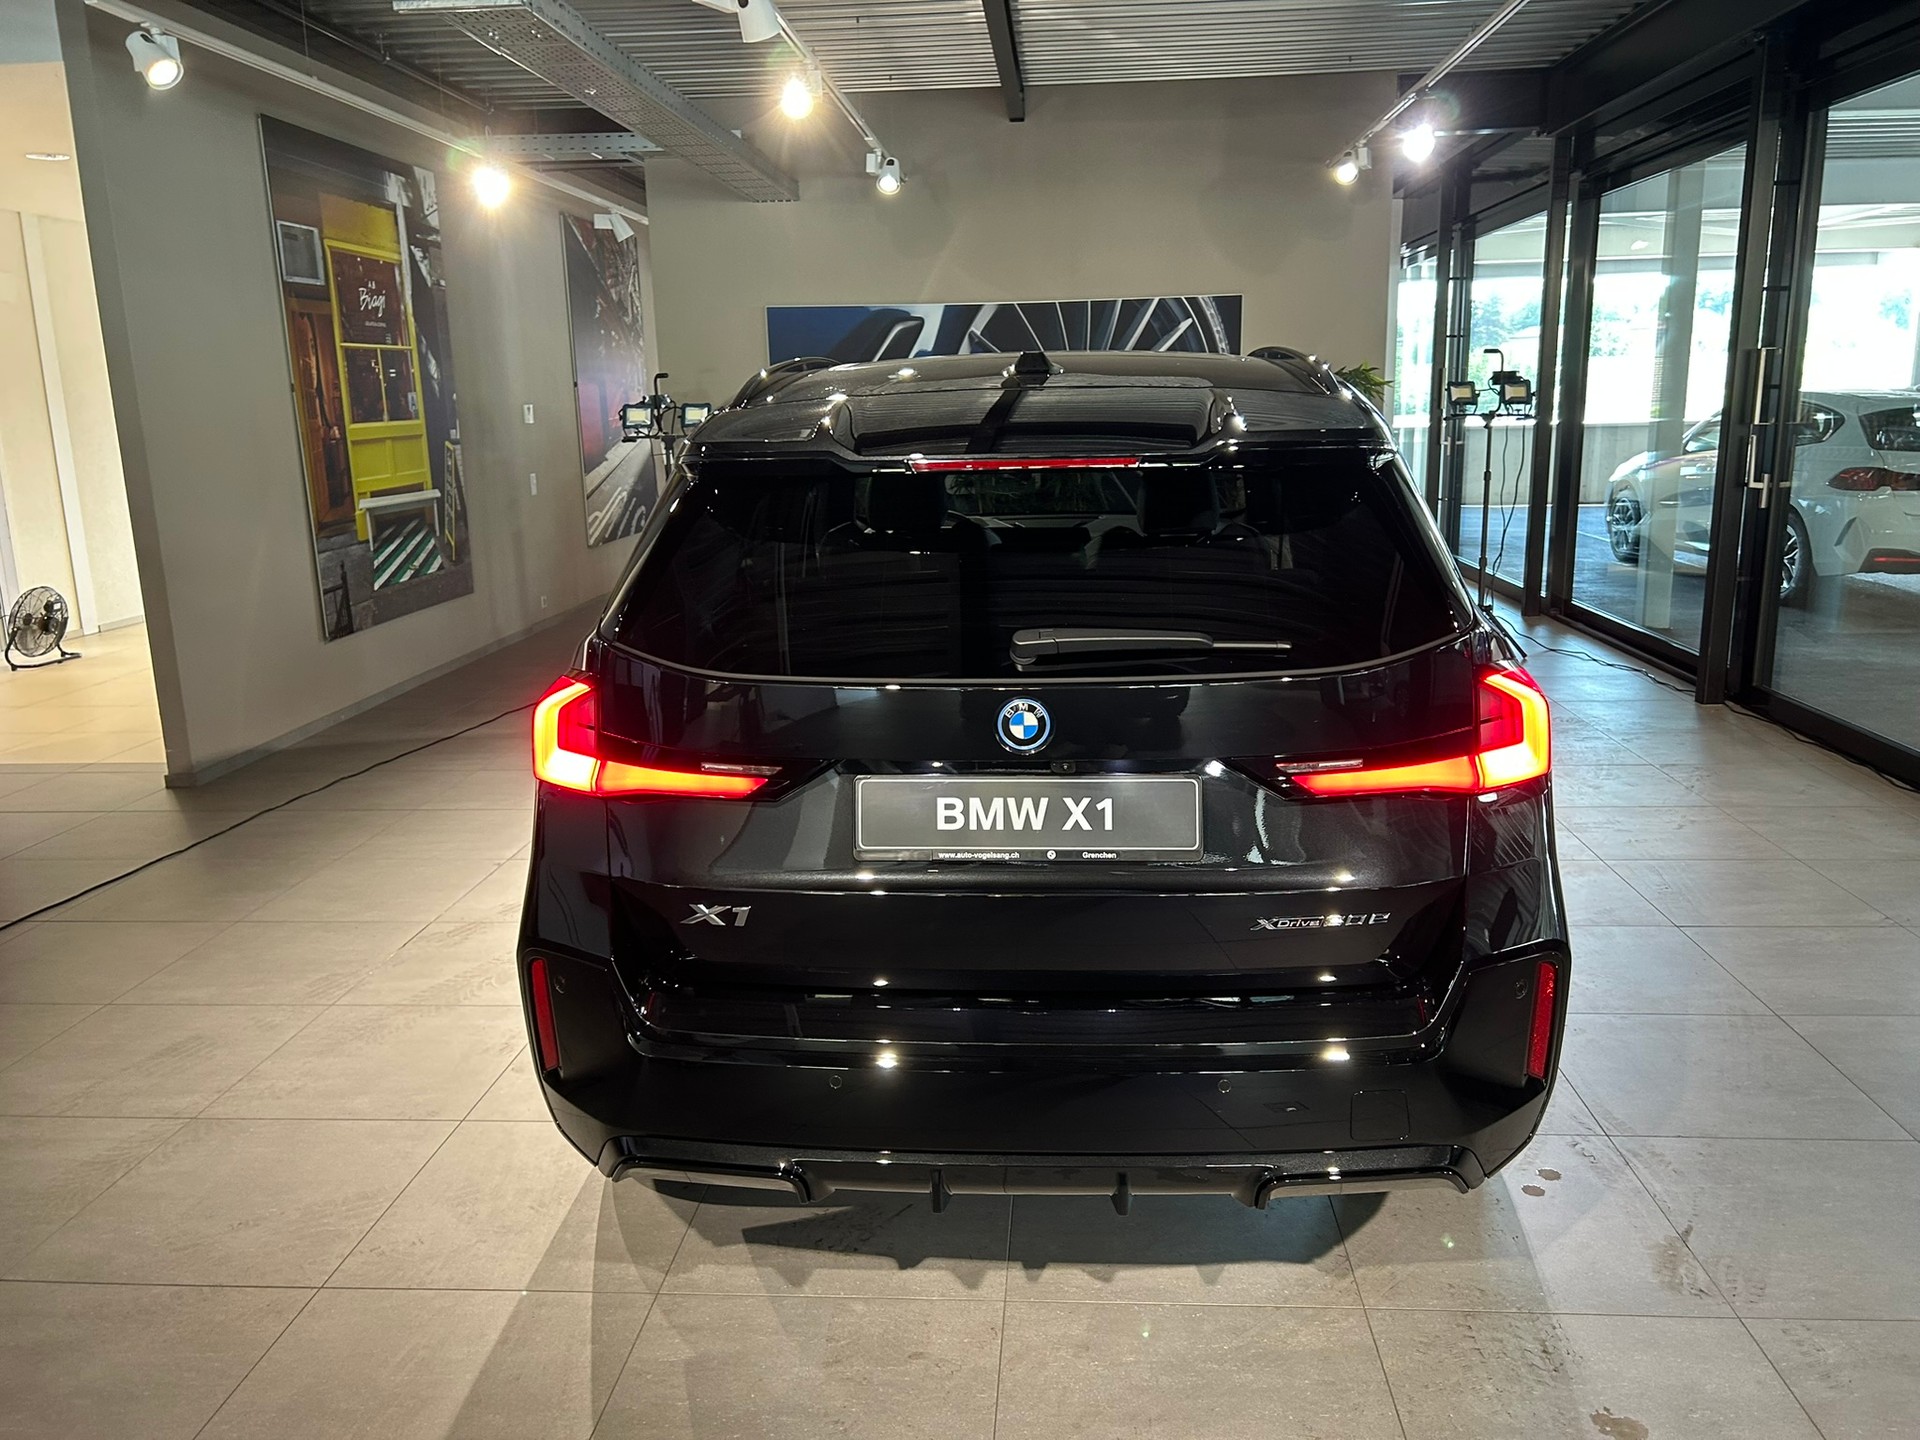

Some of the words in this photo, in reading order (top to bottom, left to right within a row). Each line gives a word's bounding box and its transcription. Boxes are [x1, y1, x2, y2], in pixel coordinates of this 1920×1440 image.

[1004, 703, 1044, 718] BMW
[936, 797, 1048, 831] BMW
[1062, 797, 1114, 831] X1
[938, 852, 1020, 861] www.auto-vogelsang.ch
[1082, 852, 1117, 860] Grenchen
[680, 903, 751, 927] X1
